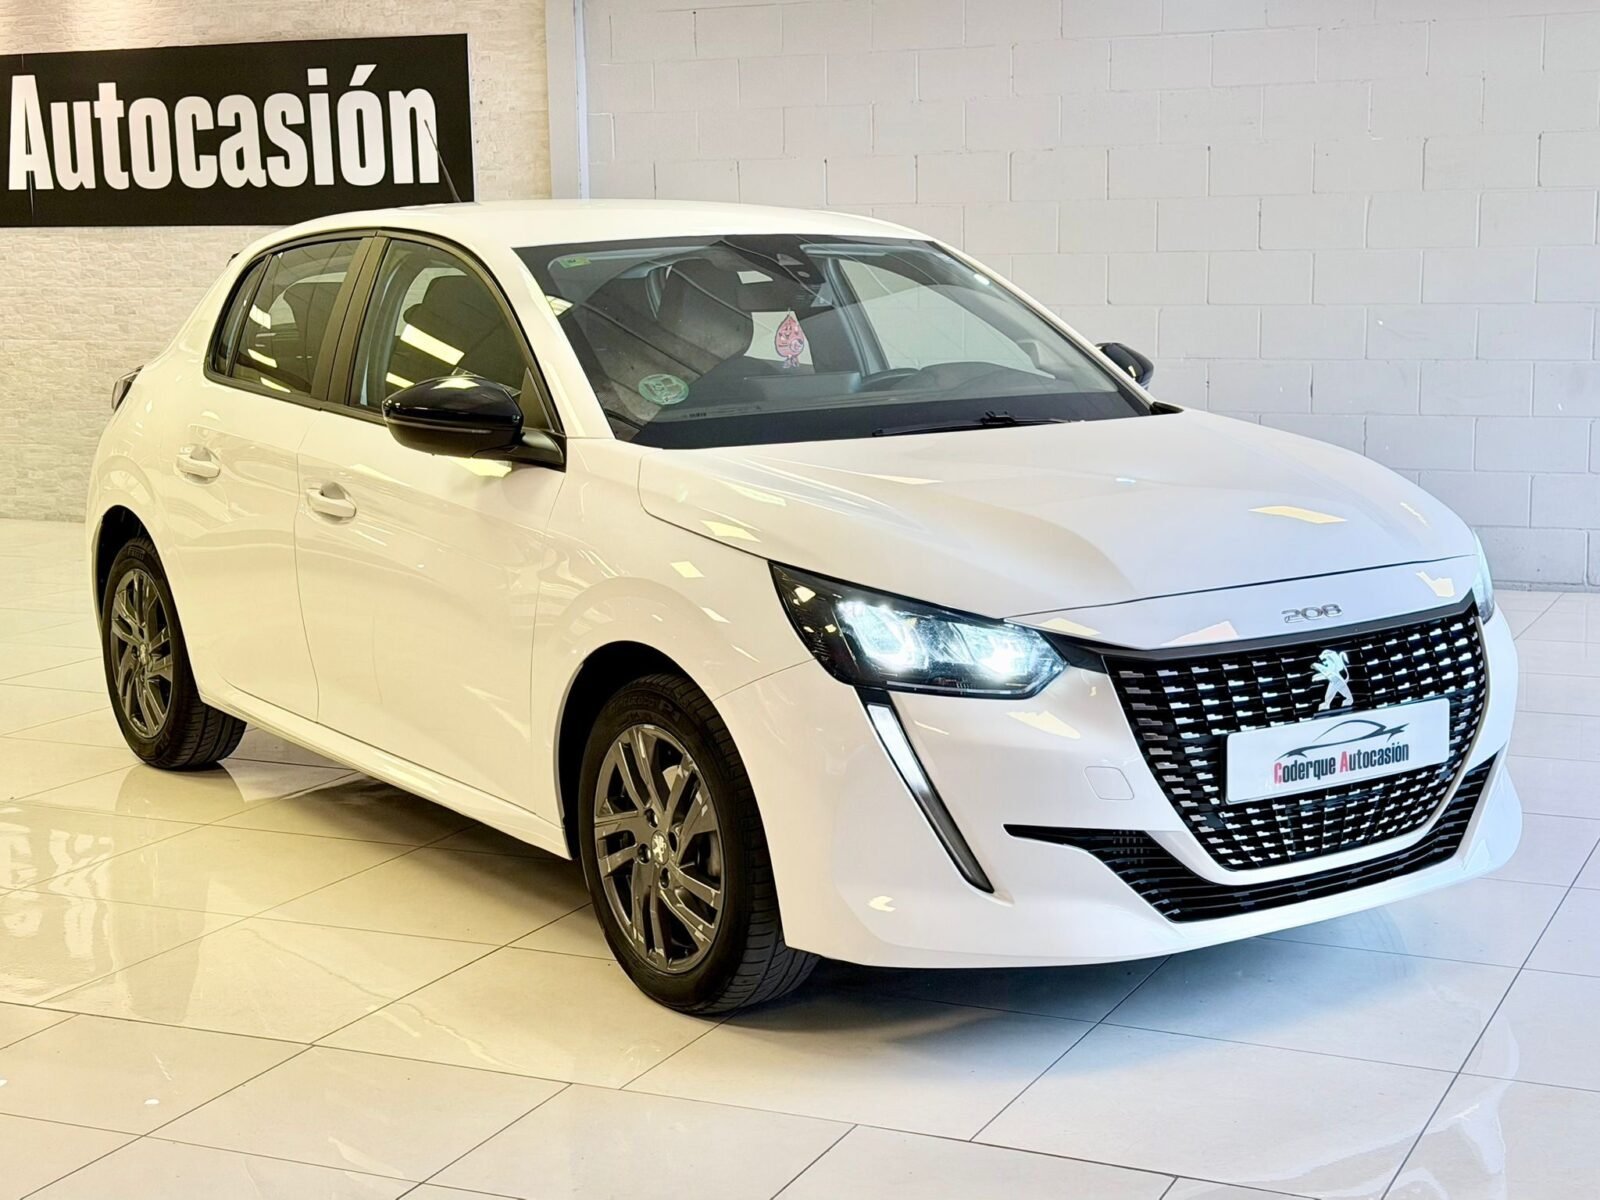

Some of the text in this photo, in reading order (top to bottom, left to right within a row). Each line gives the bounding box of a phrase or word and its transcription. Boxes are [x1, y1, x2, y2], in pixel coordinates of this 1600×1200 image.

[8, 64, 440, 191] Autocasión
[1281, 603, 1342, 624] 208
[1274, 742, 1409, 784] Coderque Autocasión
